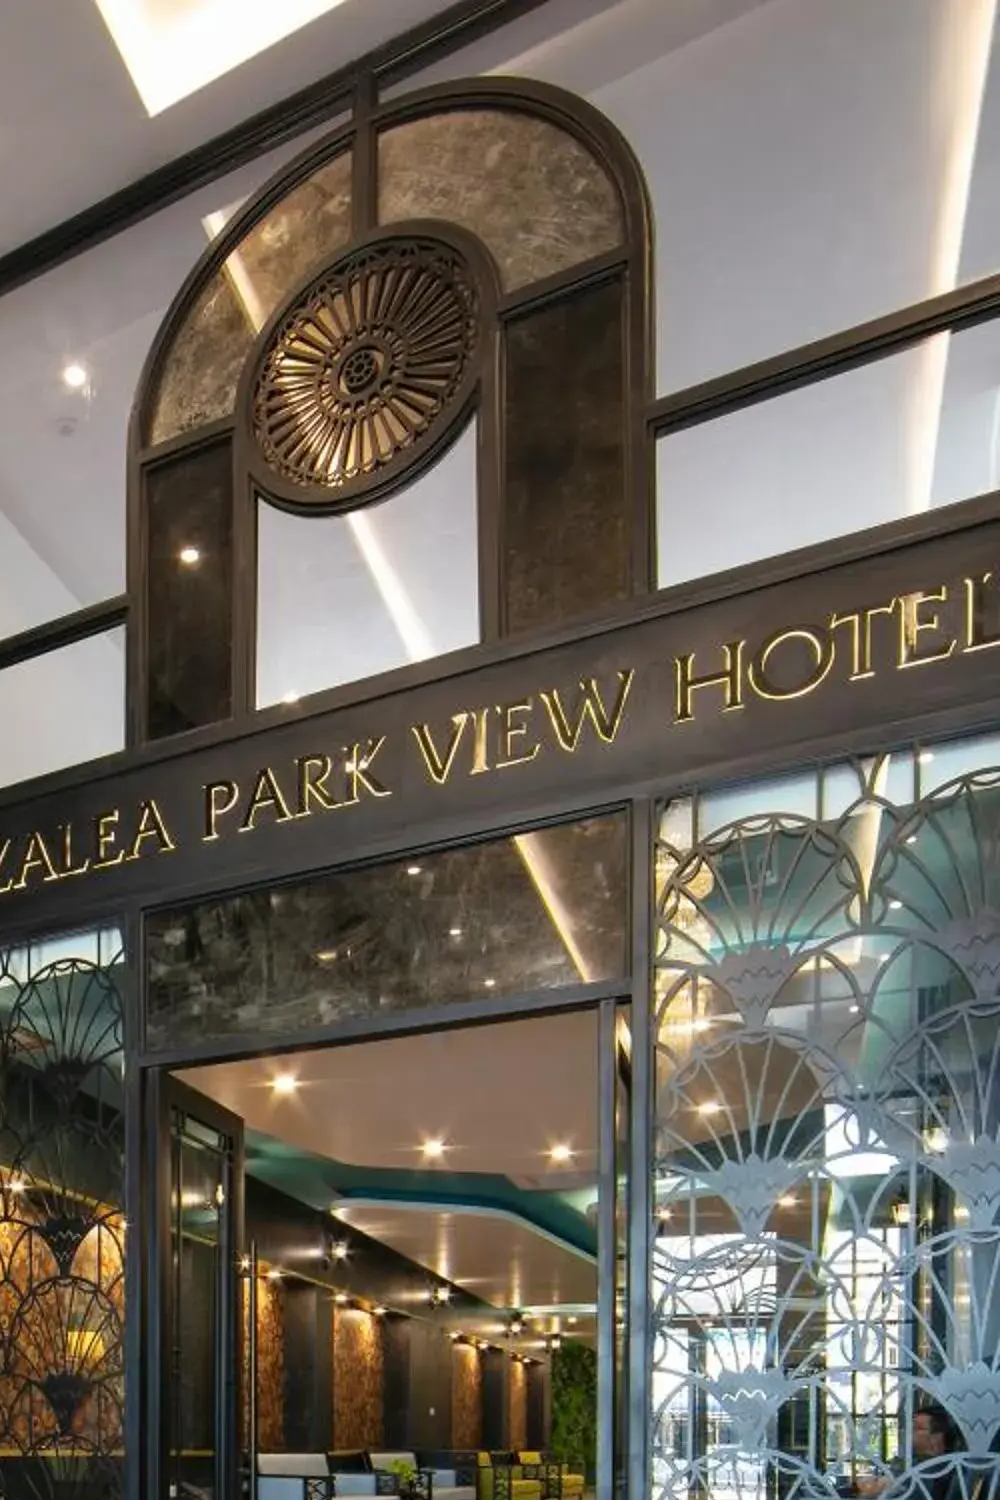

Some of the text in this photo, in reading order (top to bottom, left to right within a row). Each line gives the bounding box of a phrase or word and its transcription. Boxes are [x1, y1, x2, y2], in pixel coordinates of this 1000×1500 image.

[200, 735, 393, 841] PARK
[411, 668, 635, 784] VIEW
[673, 572, 1000, 725] HOTEL
